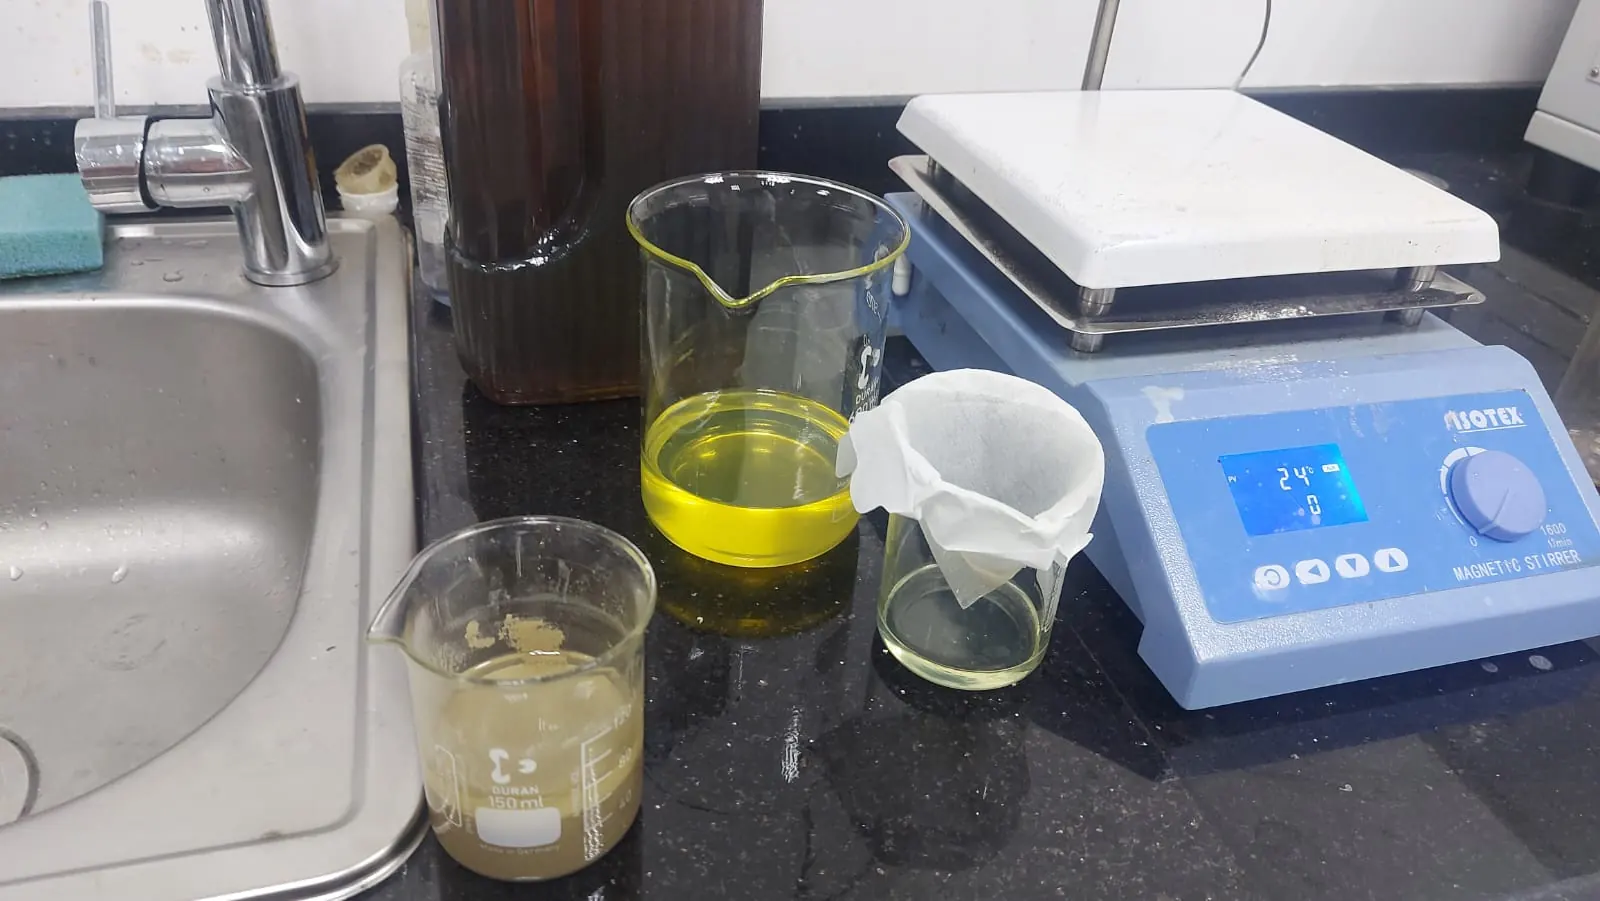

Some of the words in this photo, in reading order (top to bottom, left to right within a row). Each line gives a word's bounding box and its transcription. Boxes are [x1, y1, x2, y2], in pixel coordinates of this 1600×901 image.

[1448, 406, 1524, 430] ISOTEX
[1307, 495, 1321, 515] 0
[1540, 523, 1567, 536] 1600
[1469, 535, 1478, 547] 0
[1452, 558, 1522, 582] MAGNETIC
[1524, 549, 1582, 570] STIRRER
[492, 785, 539, 796] DURAN
[488, 796, 517, 809] 150
[520, 795, 544, 808] ml
